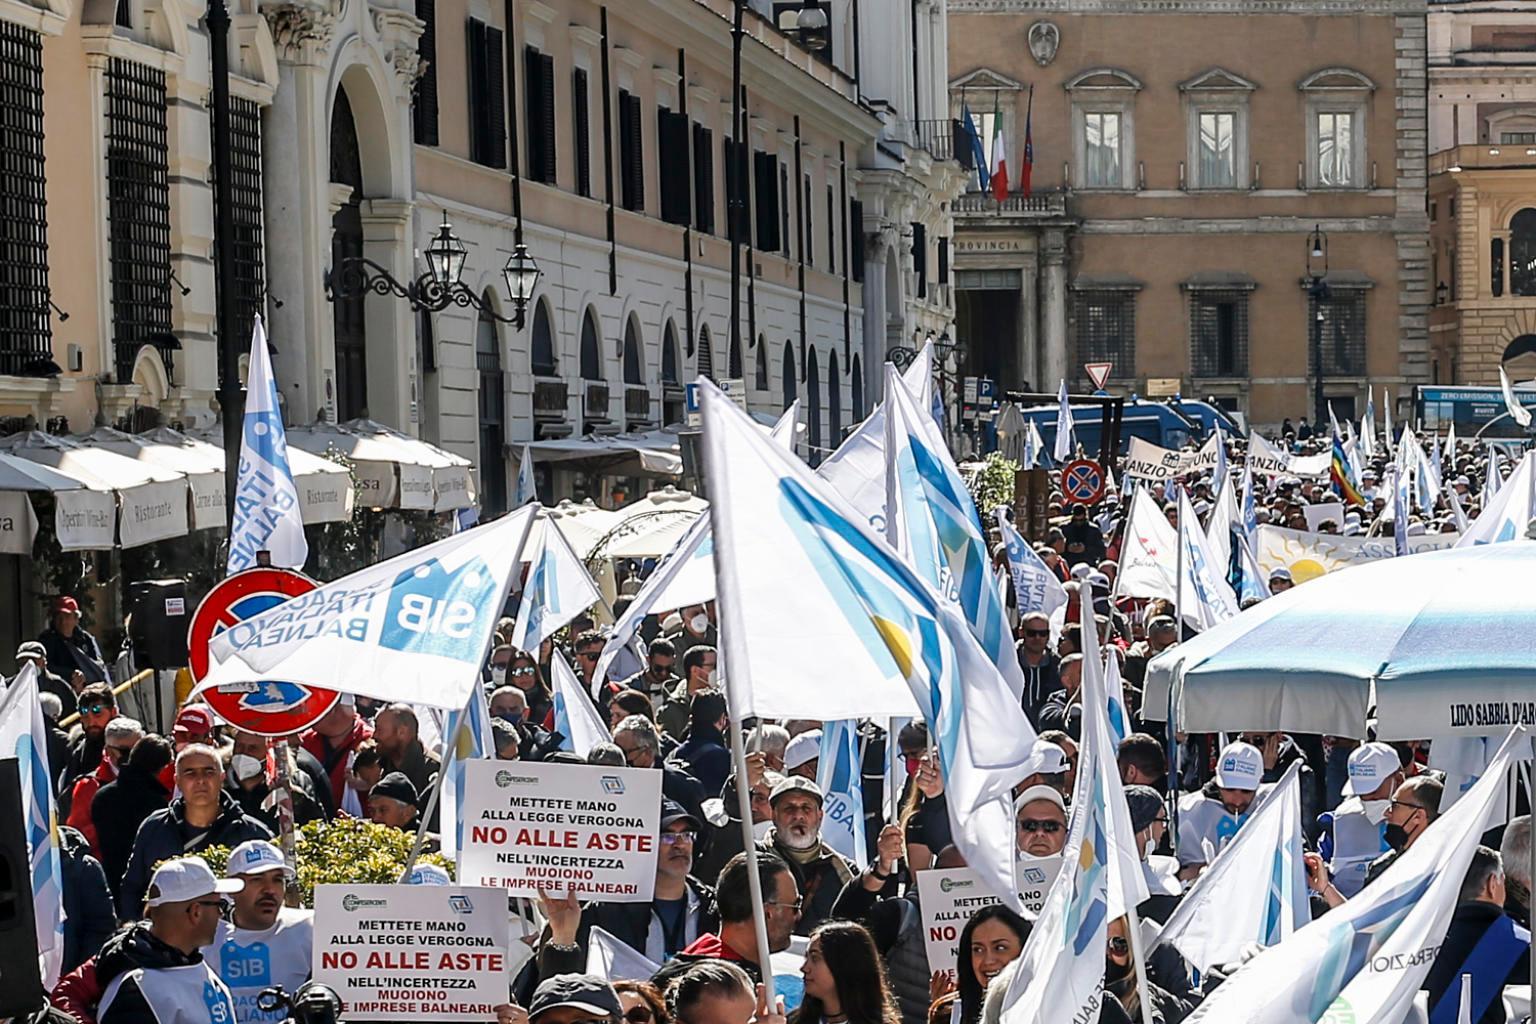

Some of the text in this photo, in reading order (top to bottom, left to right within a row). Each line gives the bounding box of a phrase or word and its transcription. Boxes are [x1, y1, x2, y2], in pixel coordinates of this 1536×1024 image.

[1128, 460, 1167, 477] ANZIO
[1450, 704, 1474, 727] LIDO
[1476, 703, 1510, 725] SABBIA
[510, 796, 617, 813] METTETE MANO
[481, 810, 644, 828] ALLA LEGGE VERGOGNA
[472, 826, 653, 853] NO ALLE ASTE
[496, 853, 625, 869] NELL'INCERTEZZA
[525, 867, 594, 880] MUOIONO
[481, 876, 638, 894] LE IMPRESE BALNEARI
[935, 911, 960, 921] ALLA
[358, 920, 466, 932] METTETE MANO
[930, 926, 957, 941] NO
[330, 935, 494, 947] ALLA LEGGE VERGOGNA
[227, 959, 264, 979] SIB
[322, 952, 503, 971] NO ALLE ASTE
[348, 977, 477, 989] NELL'INCERTEZZA
[378, 990, 447, 1000] MUOIONO
[354, 1002, 419, 1013] IMPRESE
[426, 1003, 492, 1014] BALNEARI
